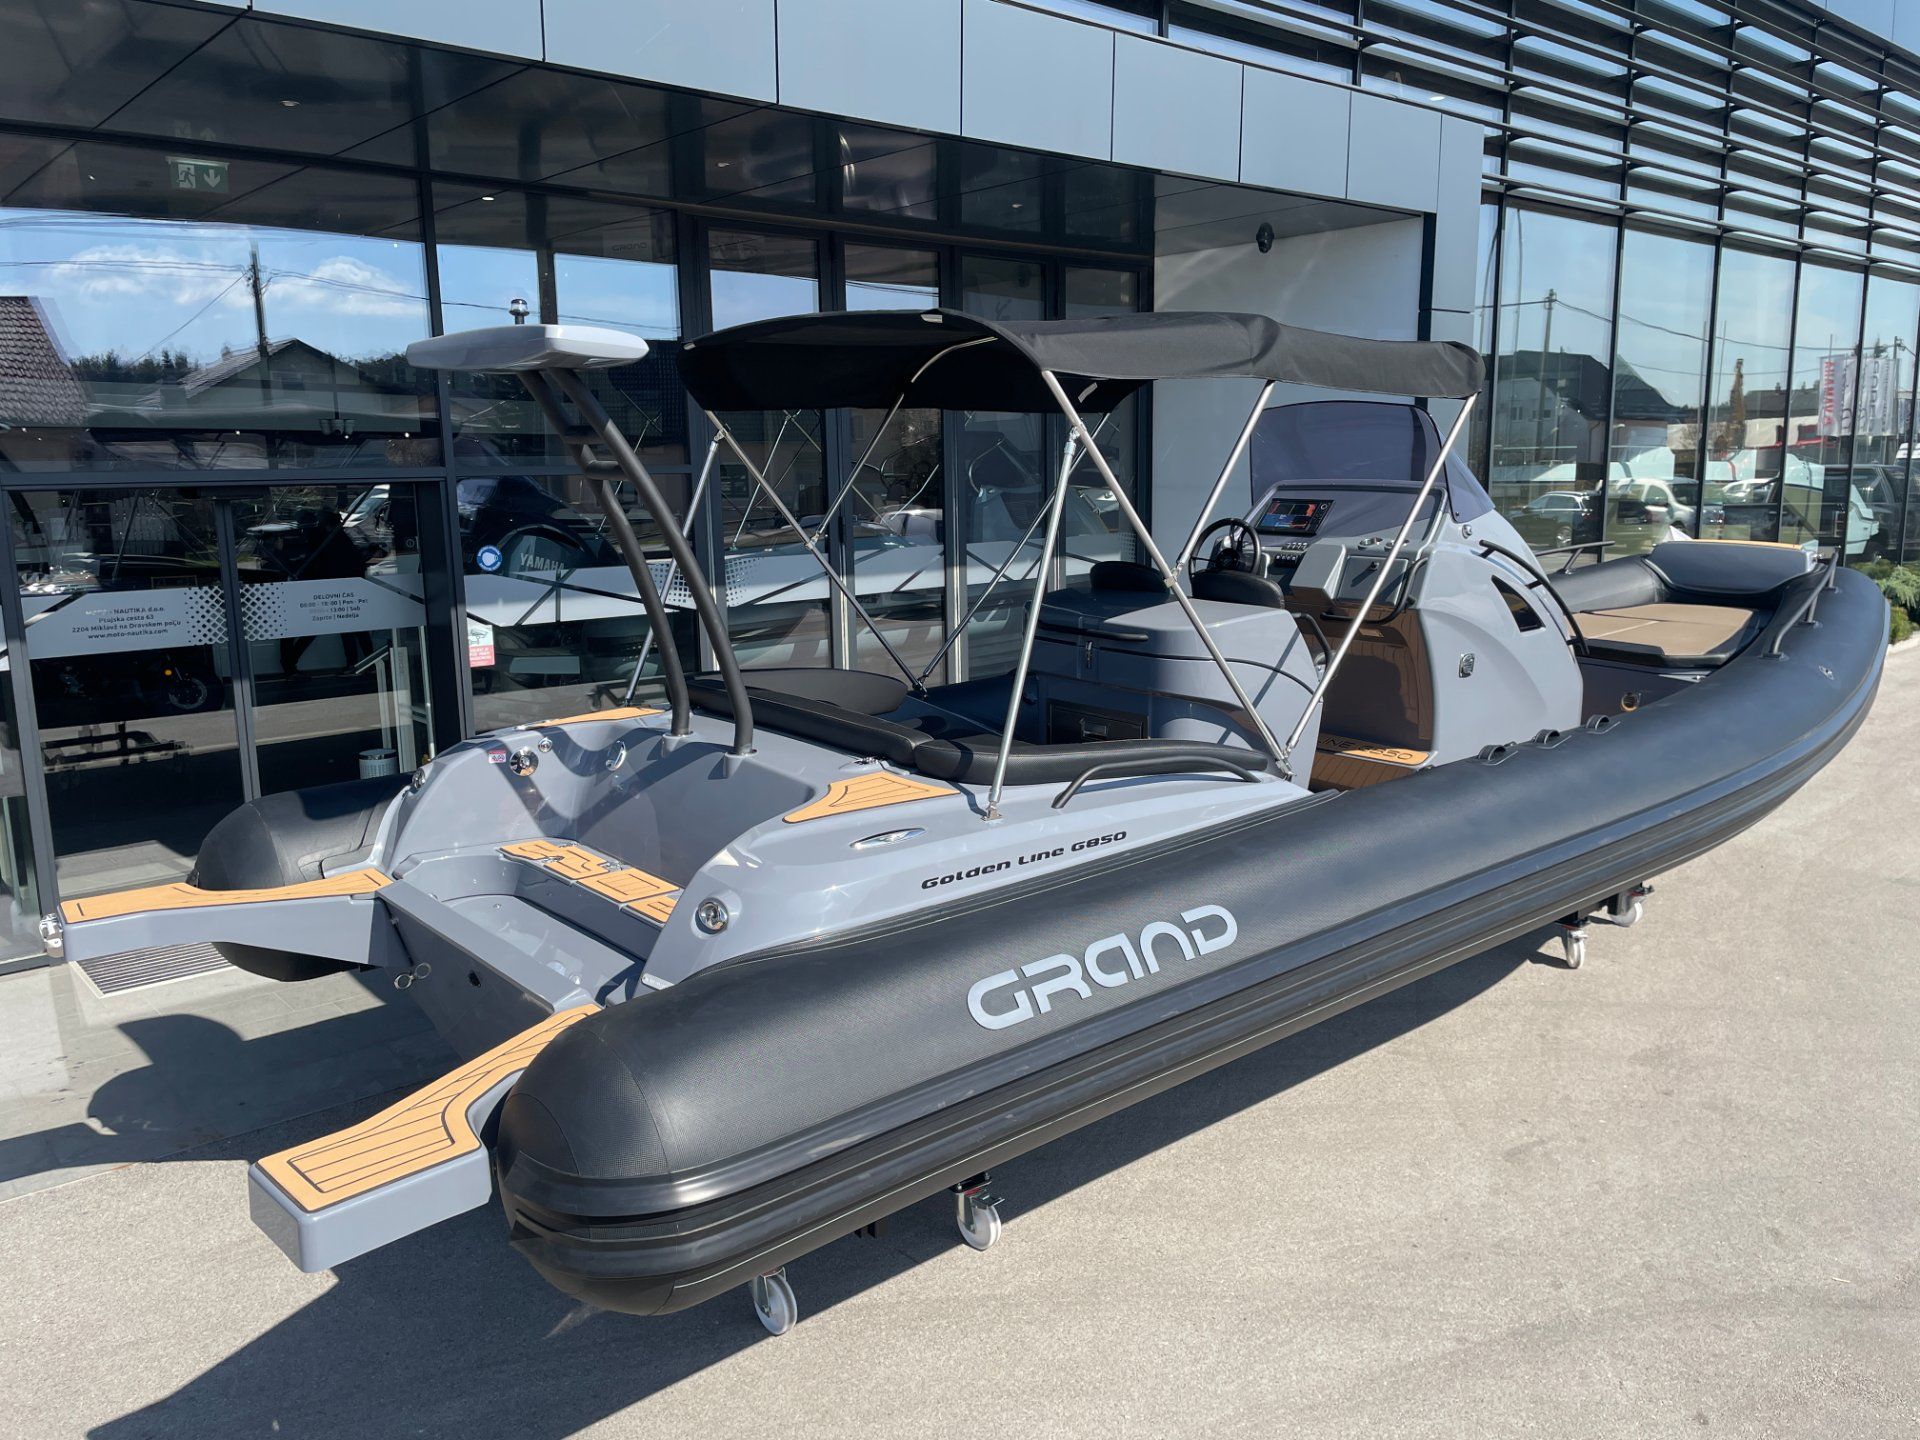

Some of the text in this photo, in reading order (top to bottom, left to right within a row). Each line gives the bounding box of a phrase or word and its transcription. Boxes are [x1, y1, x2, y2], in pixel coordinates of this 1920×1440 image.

[520, 553, 565, 571] YAMAHA
[1318, 738, 1355, 749] INE
[921, 830, 1127, 890] Golden Line G850
[967, 904, 1238, 1030] GRAND
